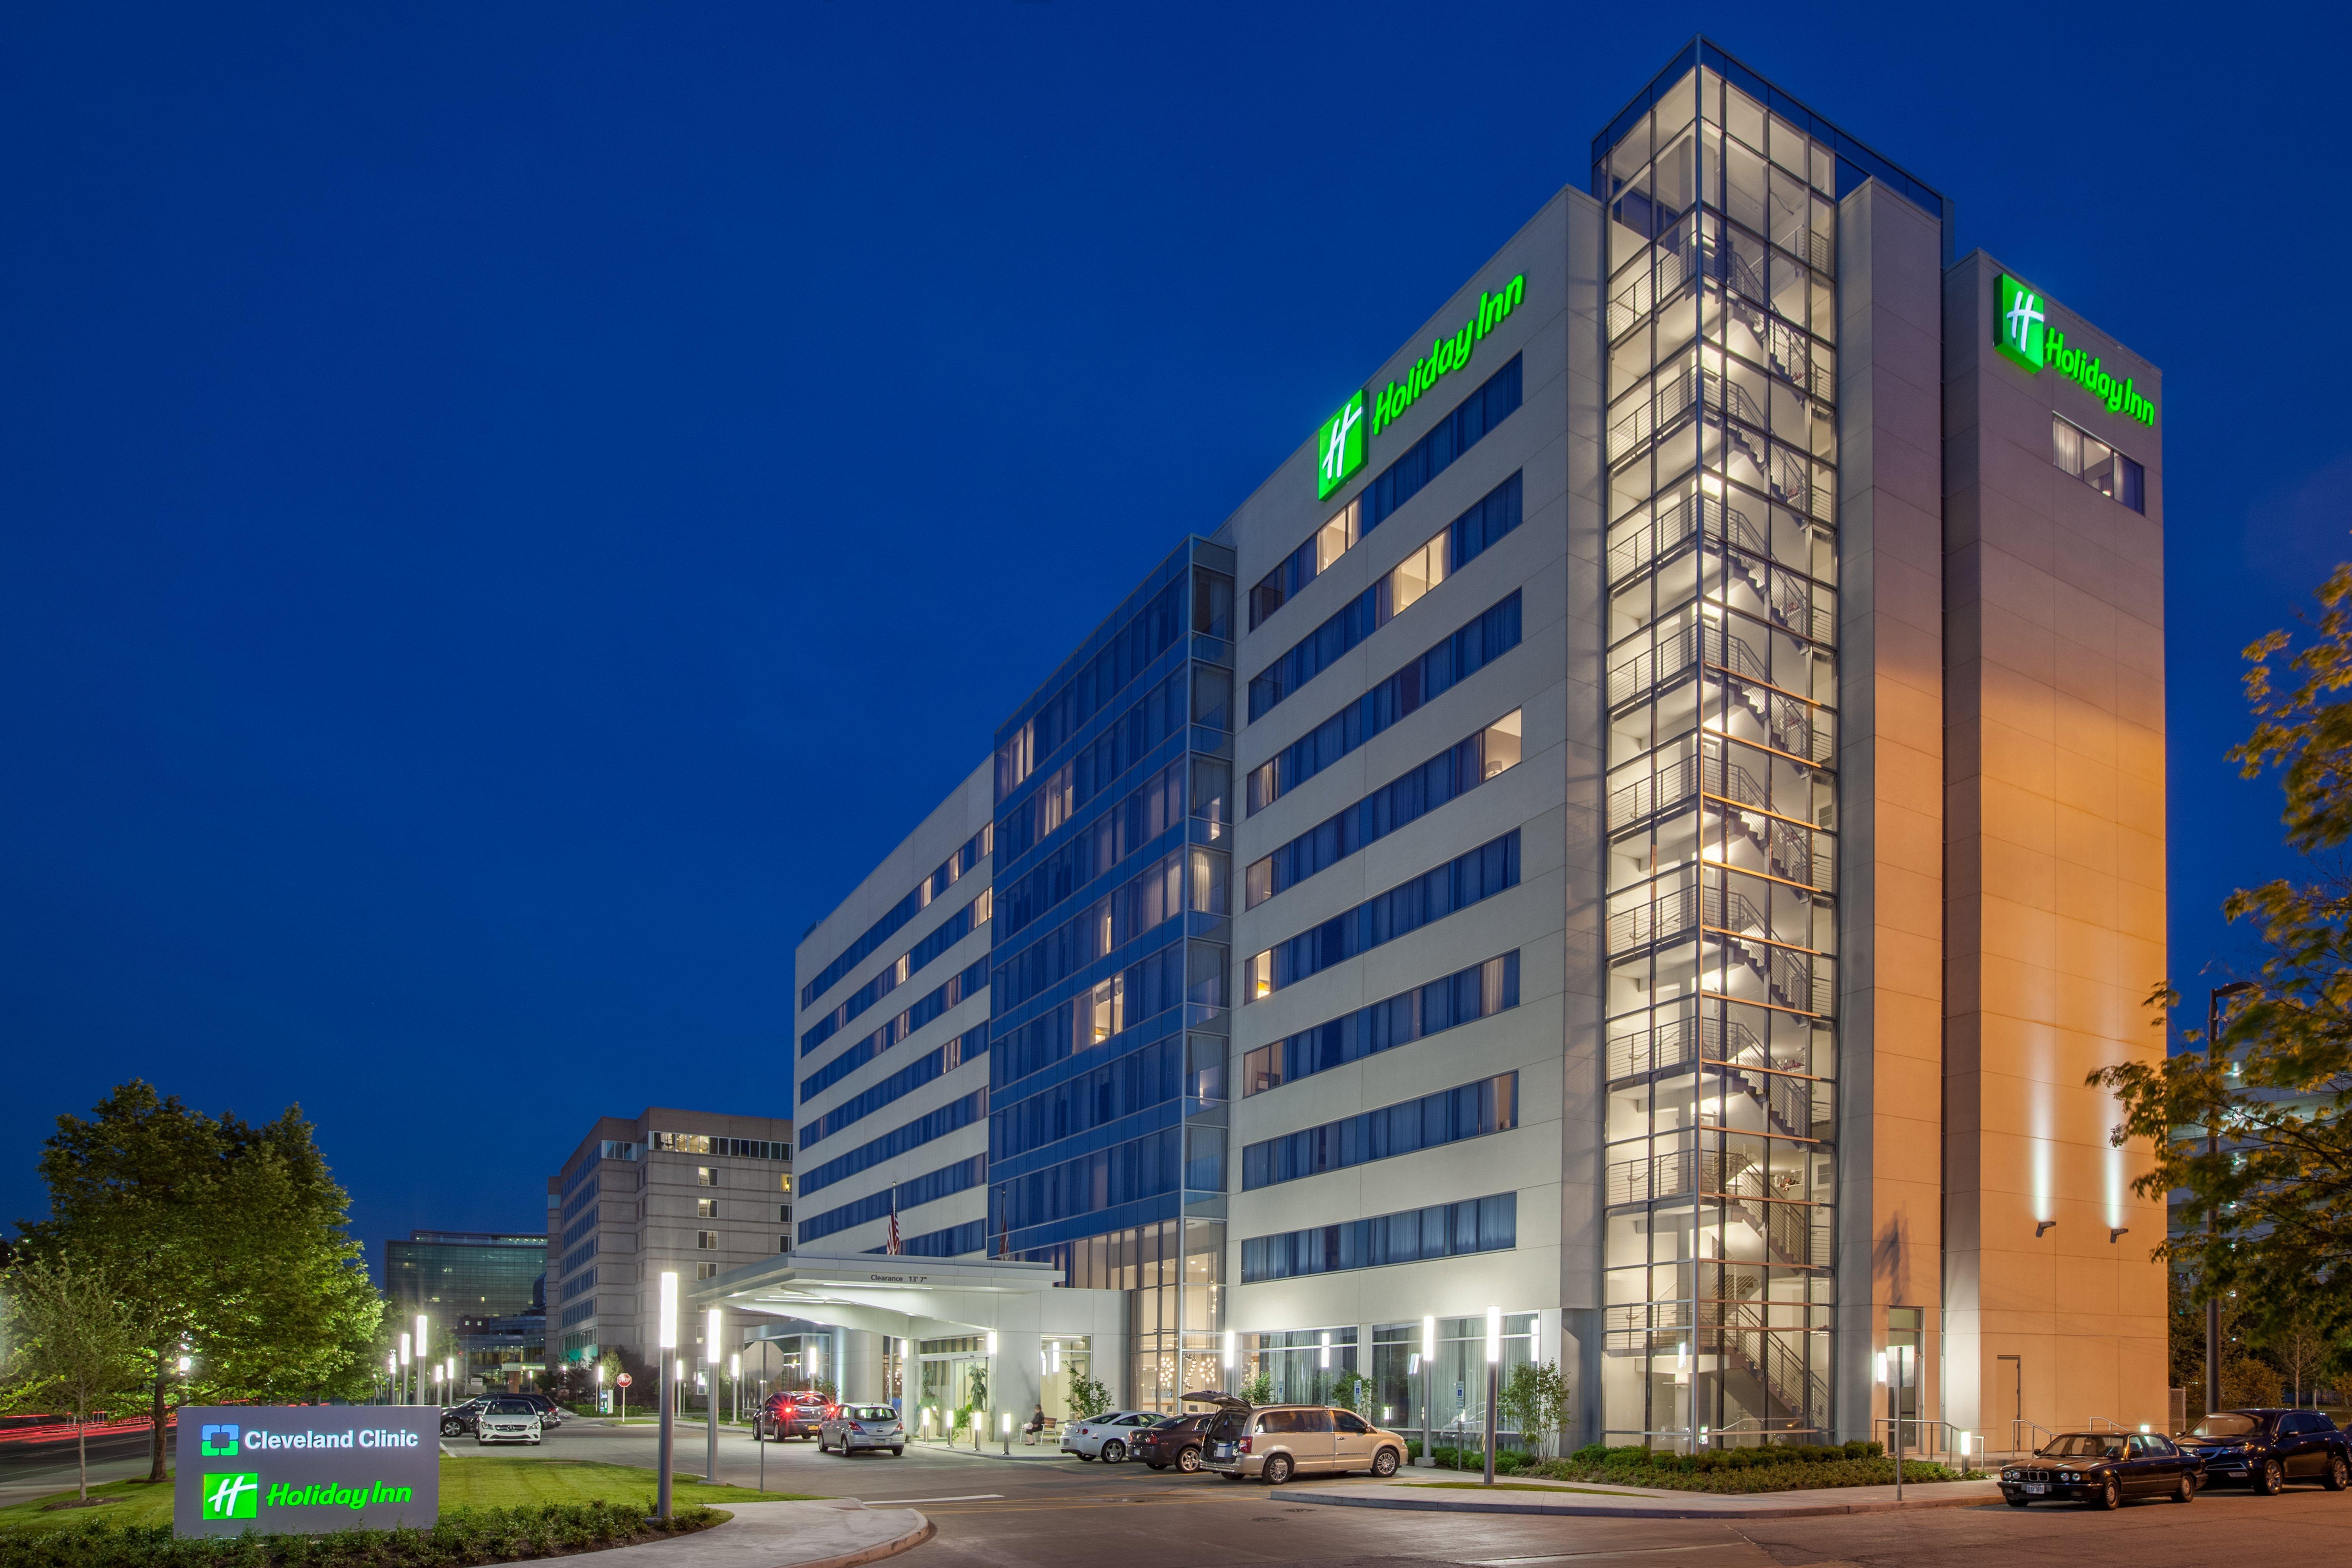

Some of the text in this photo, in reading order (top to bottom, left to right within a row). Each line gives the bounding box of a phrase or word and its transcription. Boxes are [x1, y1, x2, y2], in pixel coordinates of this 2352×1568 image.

[1372, 274, 1525, 436] Holiday Inn
[2043, 326, 2156, 428] Holiday Inn
[244, 1429, 418, 1450] Cleveland Clinic
[265, 1480, 413, 1510] Holiday Inn
